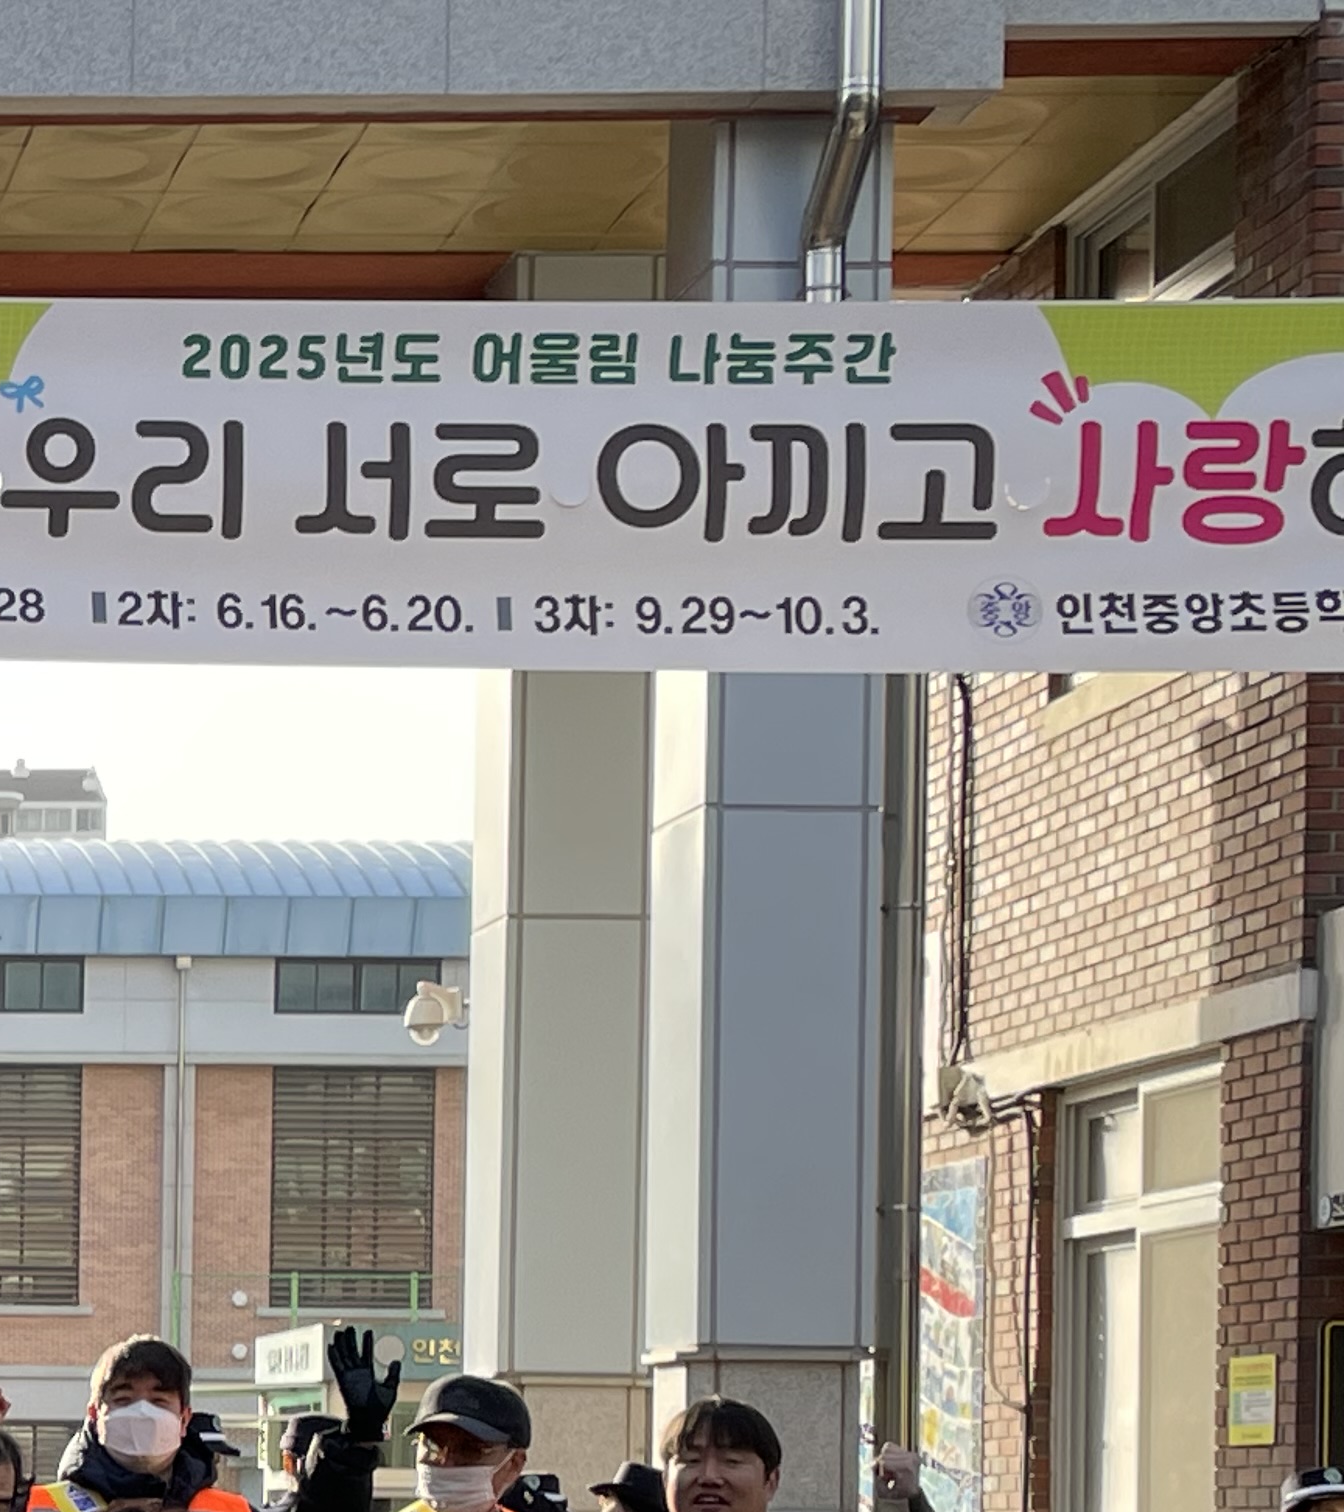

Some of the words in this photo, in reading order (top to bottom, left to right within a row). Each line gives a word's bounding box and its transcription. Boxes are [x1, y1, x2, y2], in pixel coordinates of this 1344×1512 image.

[182, 332, 441, 384] 2025년도
[473, 332, 639, 386] 어울림
[669, 332, 898, 386] 나눔주간
[0, 416, 244, 538] 우리
[296, 420, 546, 540] 서로
[597, 420, 998, 542] 아끼고
[117, 578, 198, 628] 2차:
[534, 592, 616, 635] 3차:
